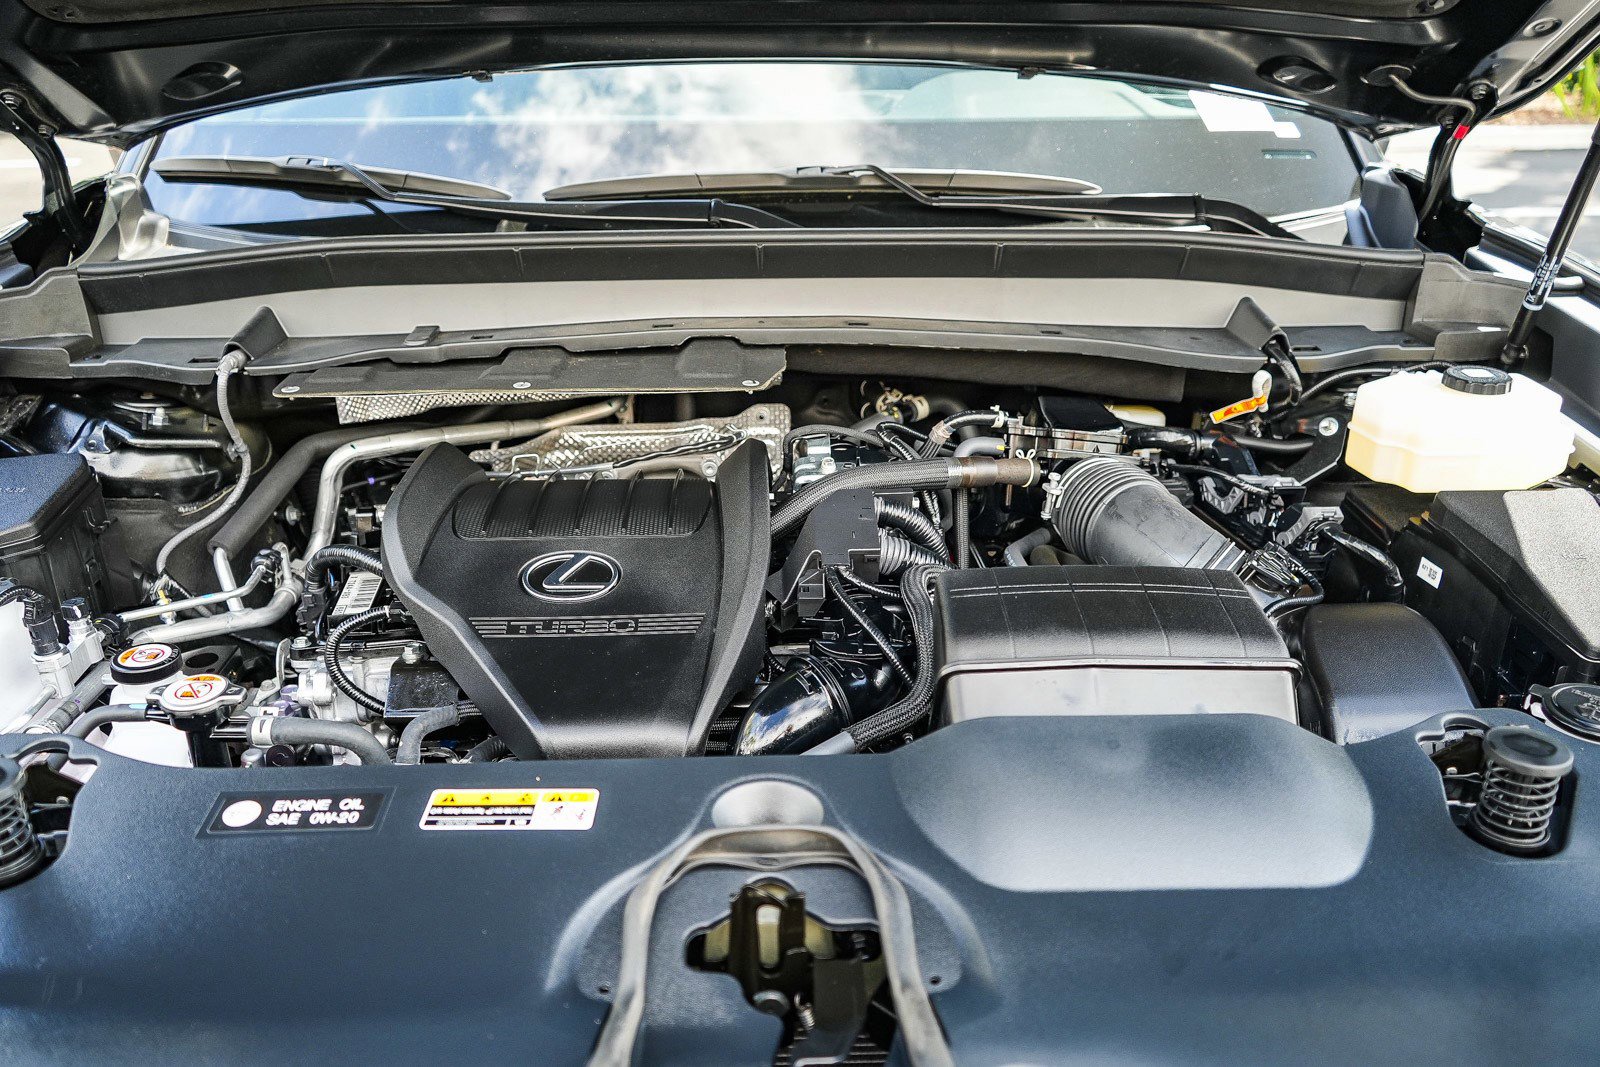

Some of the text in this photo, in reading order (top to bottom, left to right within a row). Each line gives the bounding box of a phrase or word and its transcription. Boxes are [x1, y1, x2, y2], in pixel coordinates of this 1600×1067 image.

[511, 619, 635, 634] TURBO
[272, 797, 365, 813] ENGINE OIL
[265, 811, 360, 826] SAE 0W-20
